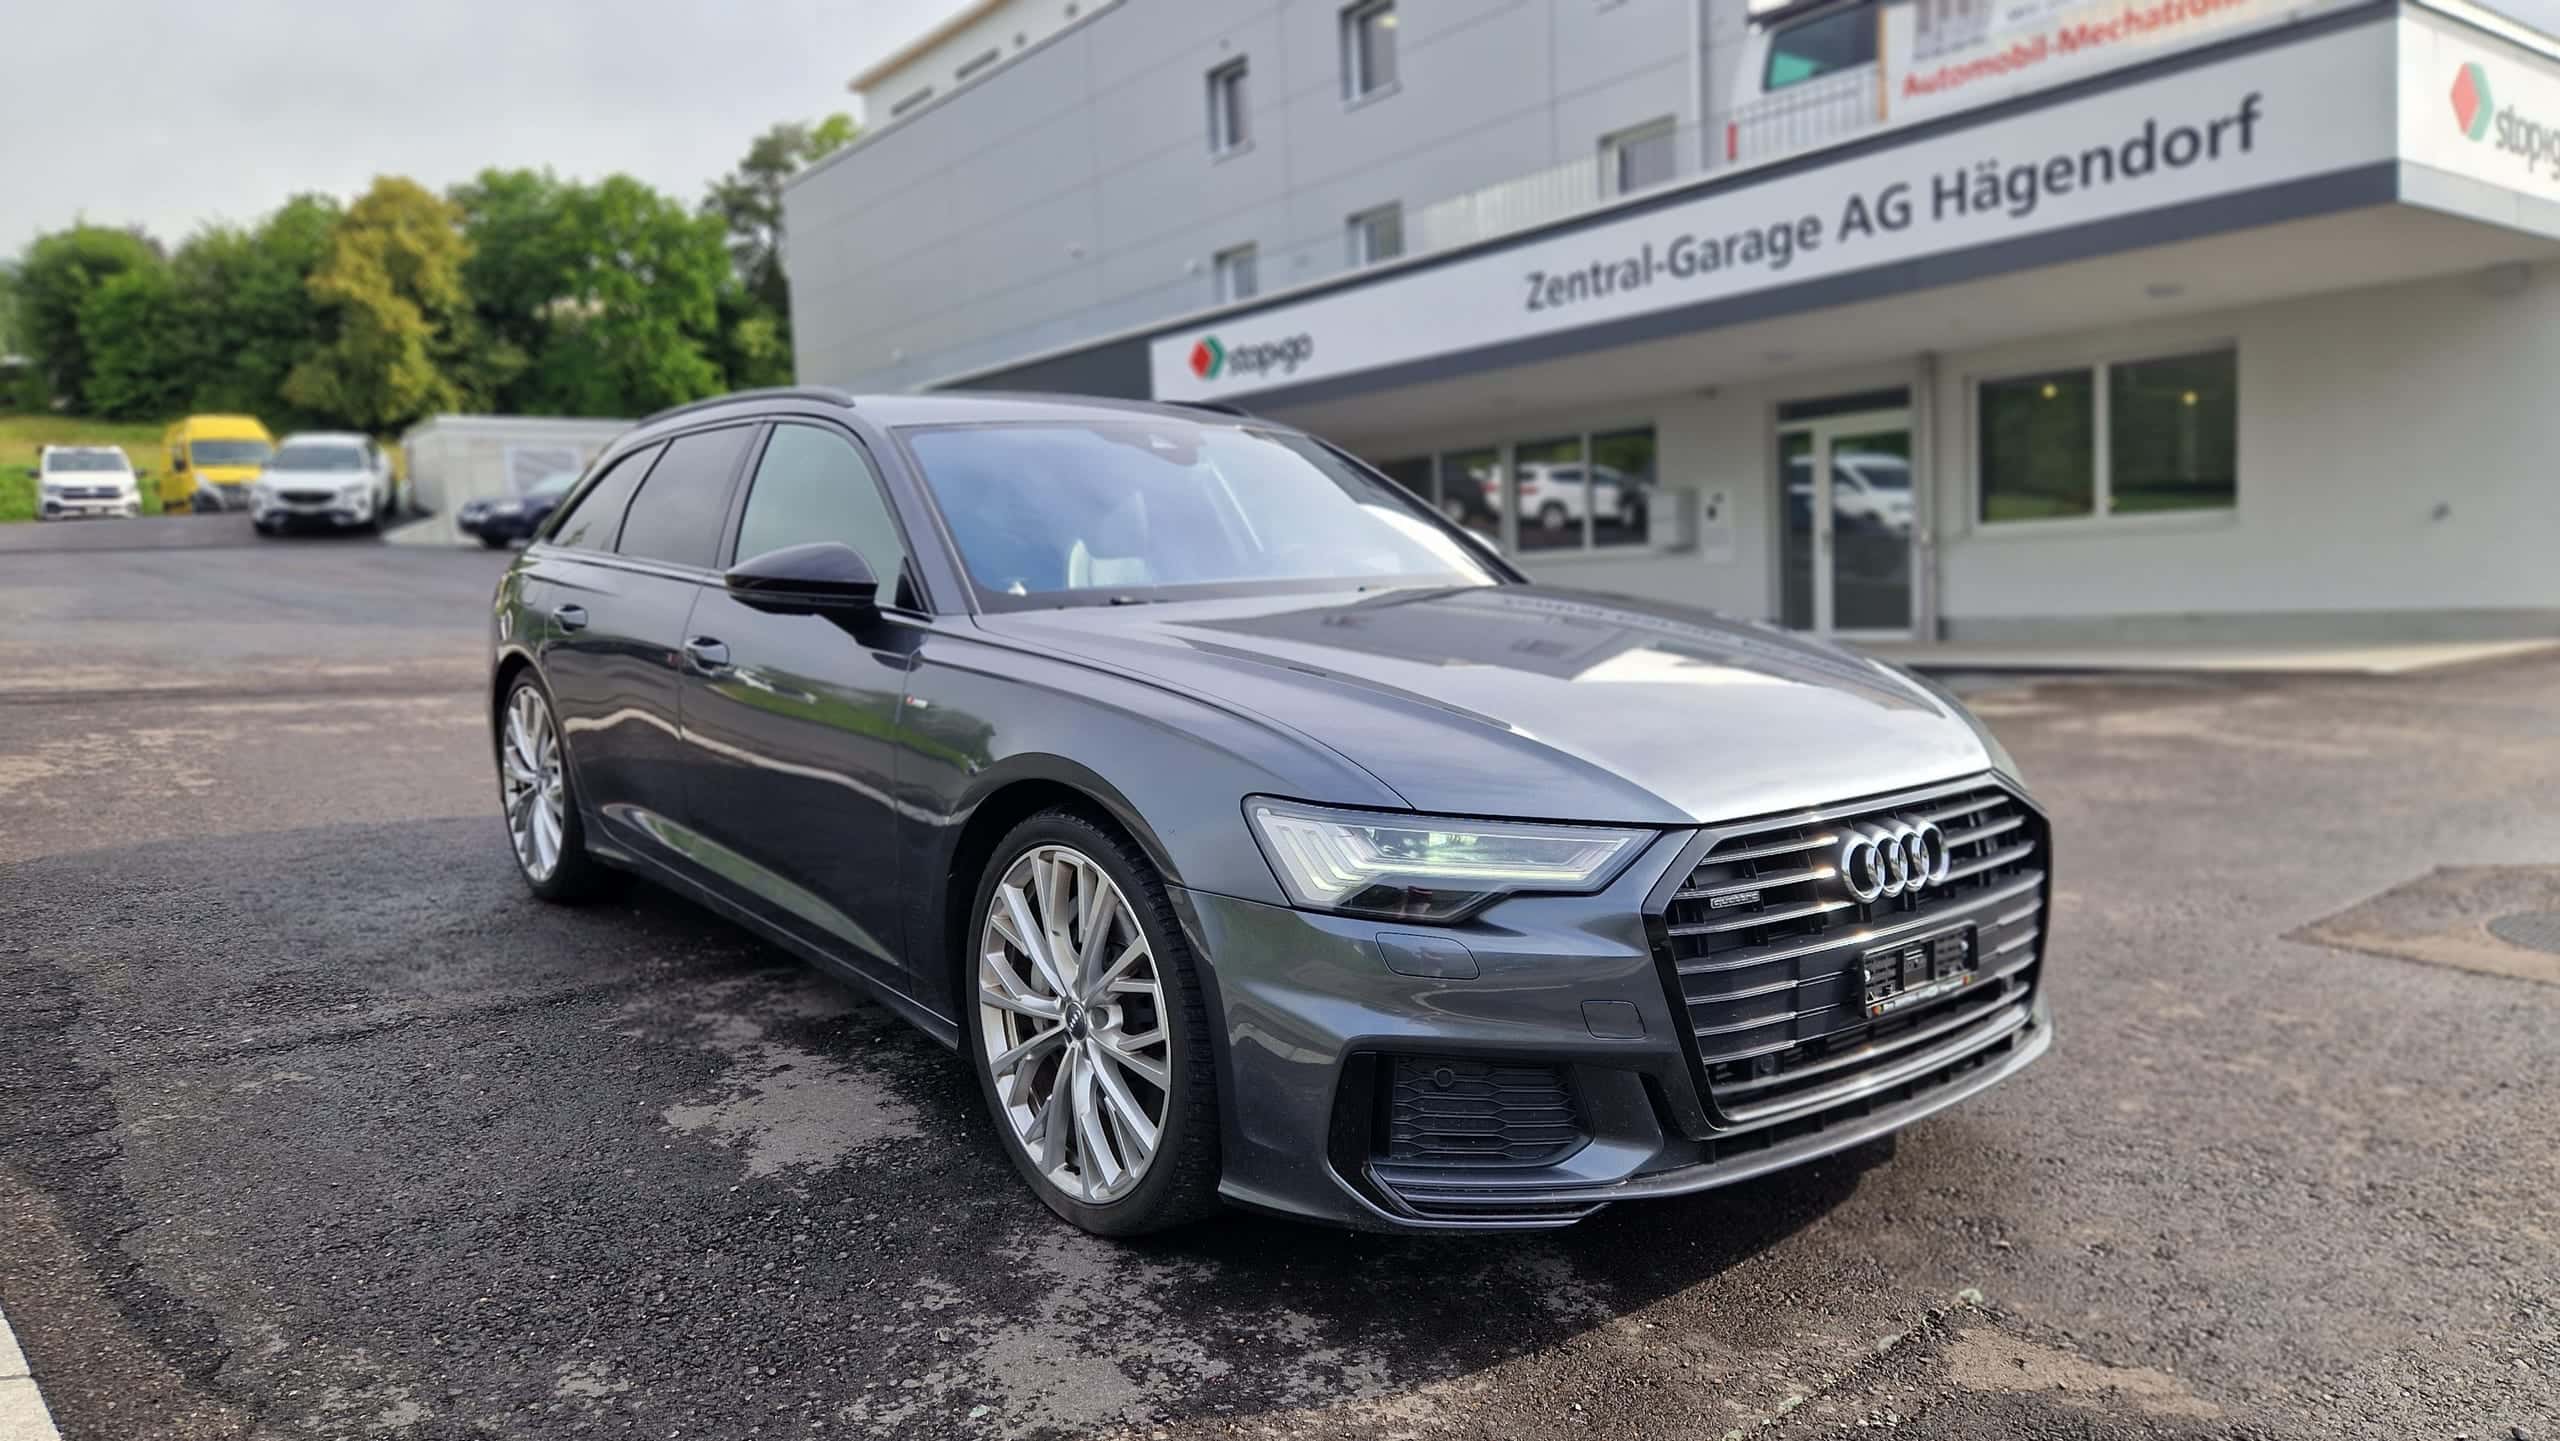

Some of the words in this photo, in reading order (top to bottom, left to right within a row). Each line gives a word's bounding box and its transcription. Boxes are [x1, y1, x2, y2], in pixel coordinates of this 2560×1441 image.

[1525, 215, 1822, 312] Zentral-Garage
[1837, 181, 1913, 242] AG
[1931, 91, 2263, 221] Hägendorf
